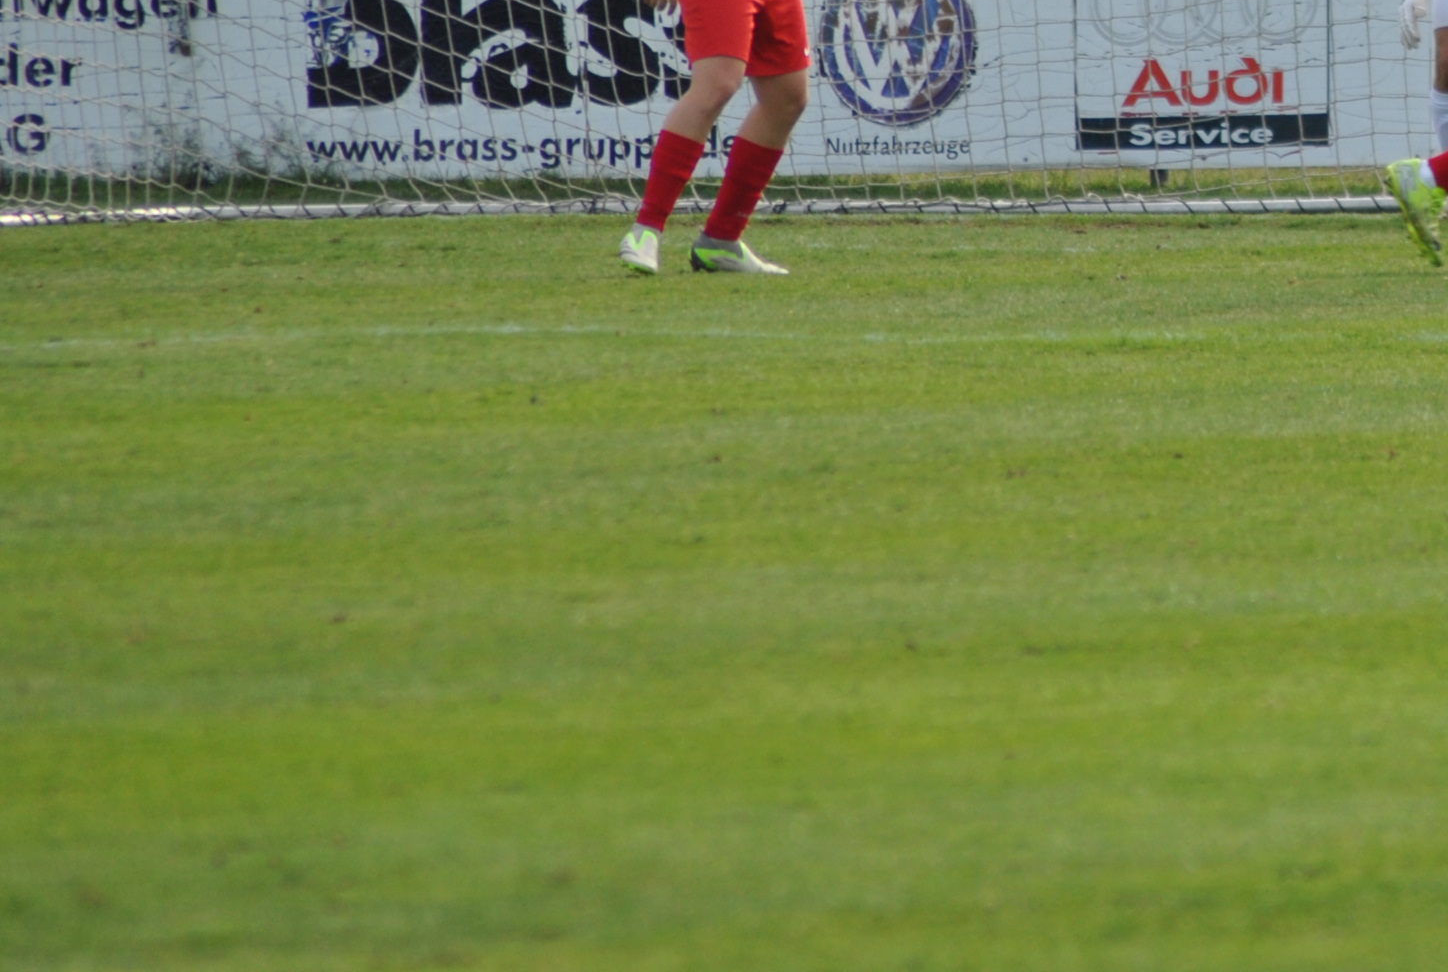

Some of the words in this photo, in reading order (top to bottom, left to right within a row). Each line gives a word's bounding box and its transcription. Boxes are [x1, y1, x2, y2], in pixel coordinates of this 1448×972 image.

[1122, 57, 1284, 106] Audi
[0, 113, 50, 155] G
[826, 135, 971, 161] Nutzfahrzeuge
[1129, 121, 1274, 147] Service
